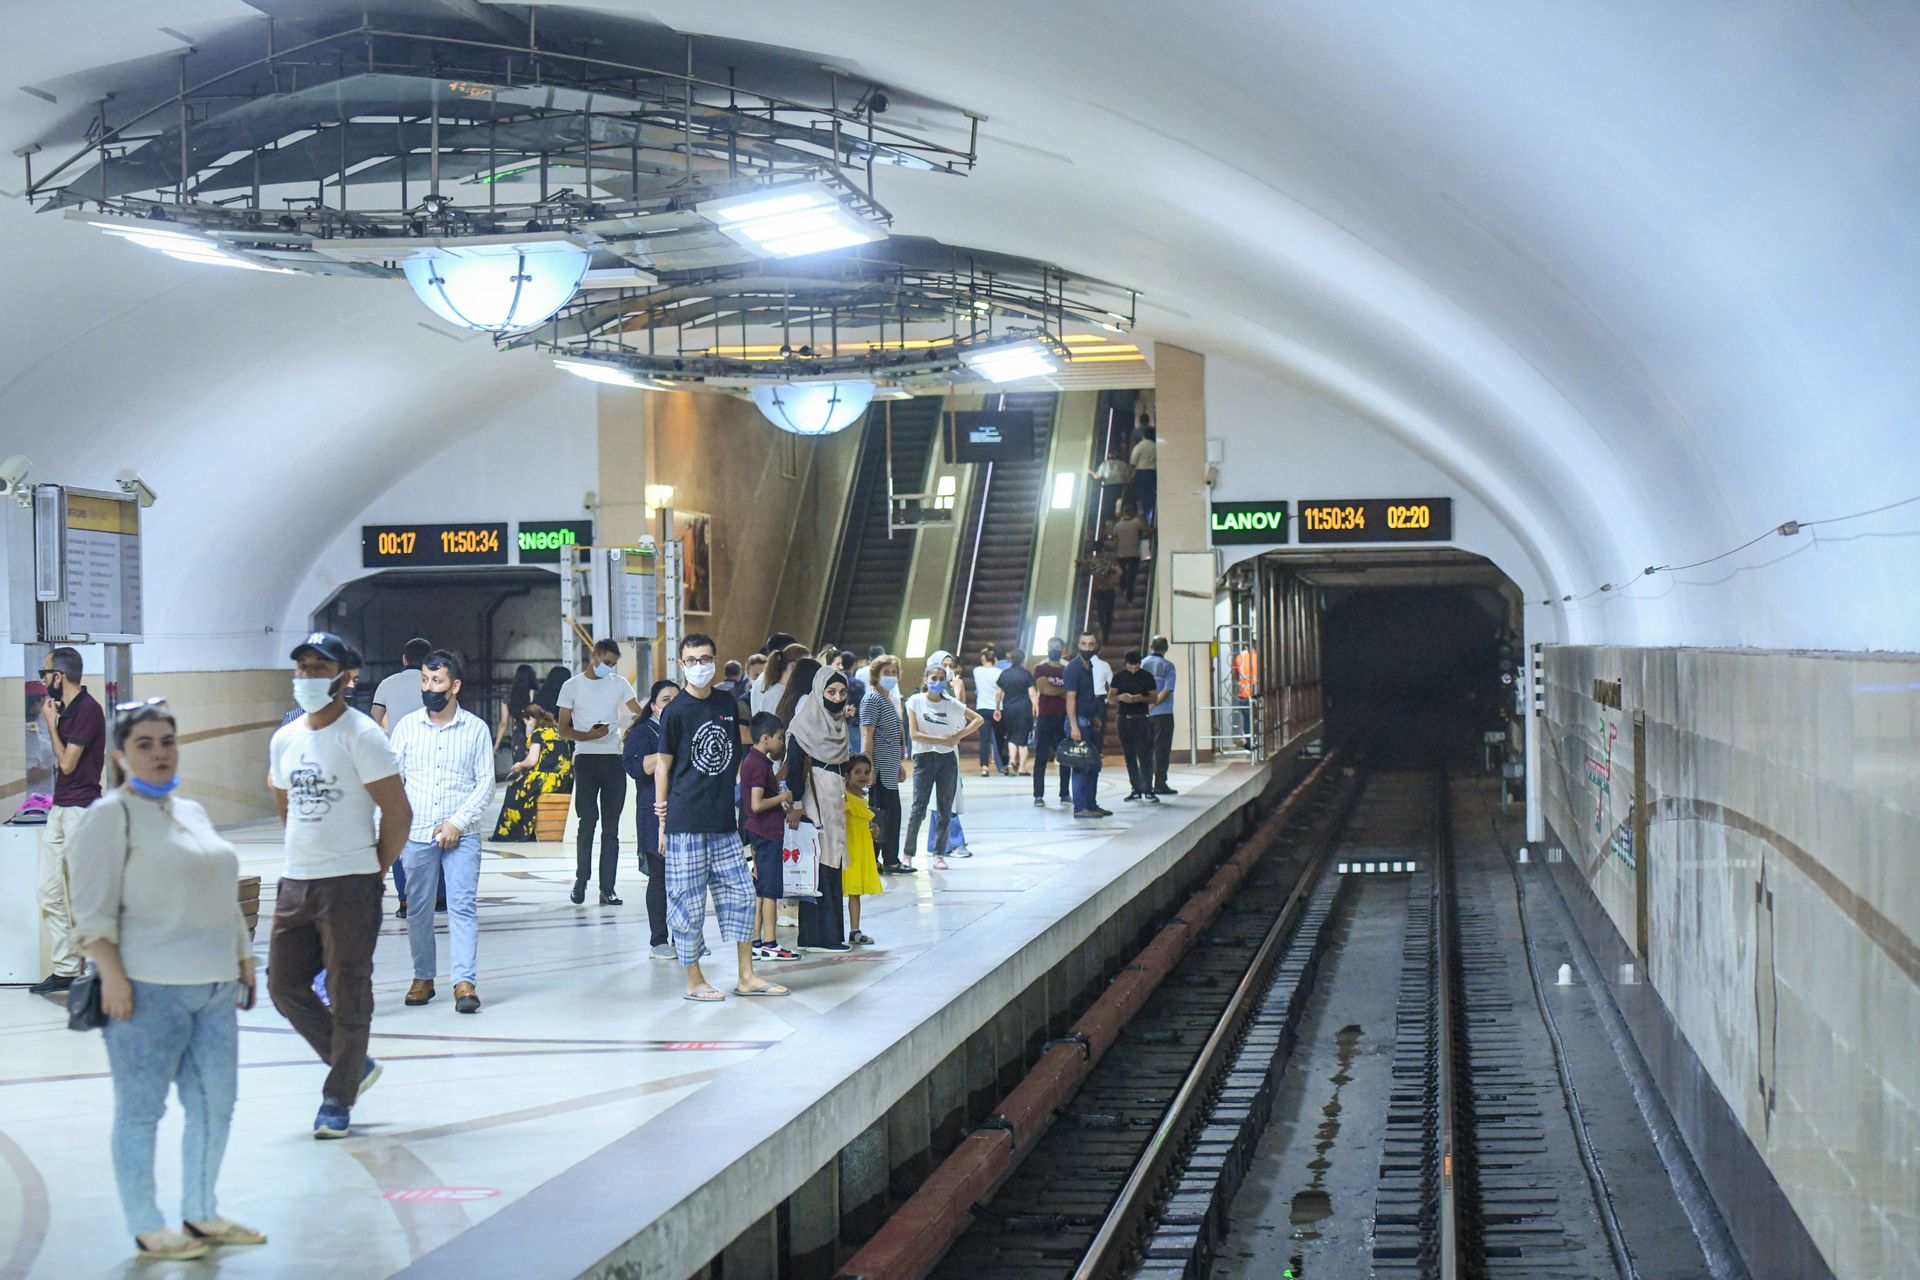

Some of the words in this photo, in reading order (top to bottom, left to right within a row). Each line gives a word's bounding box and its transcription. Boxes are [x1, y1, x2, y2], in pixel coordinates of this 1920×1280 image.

[1211, 511, 1282, 531] LANOV
[1304, 506, 1366, 530] 11:50:34
[1387, 505, 1430, 529] 02:20
[378, 532, 416, 555] 00:17
[441, 530, 499, 553] 11:50:34
